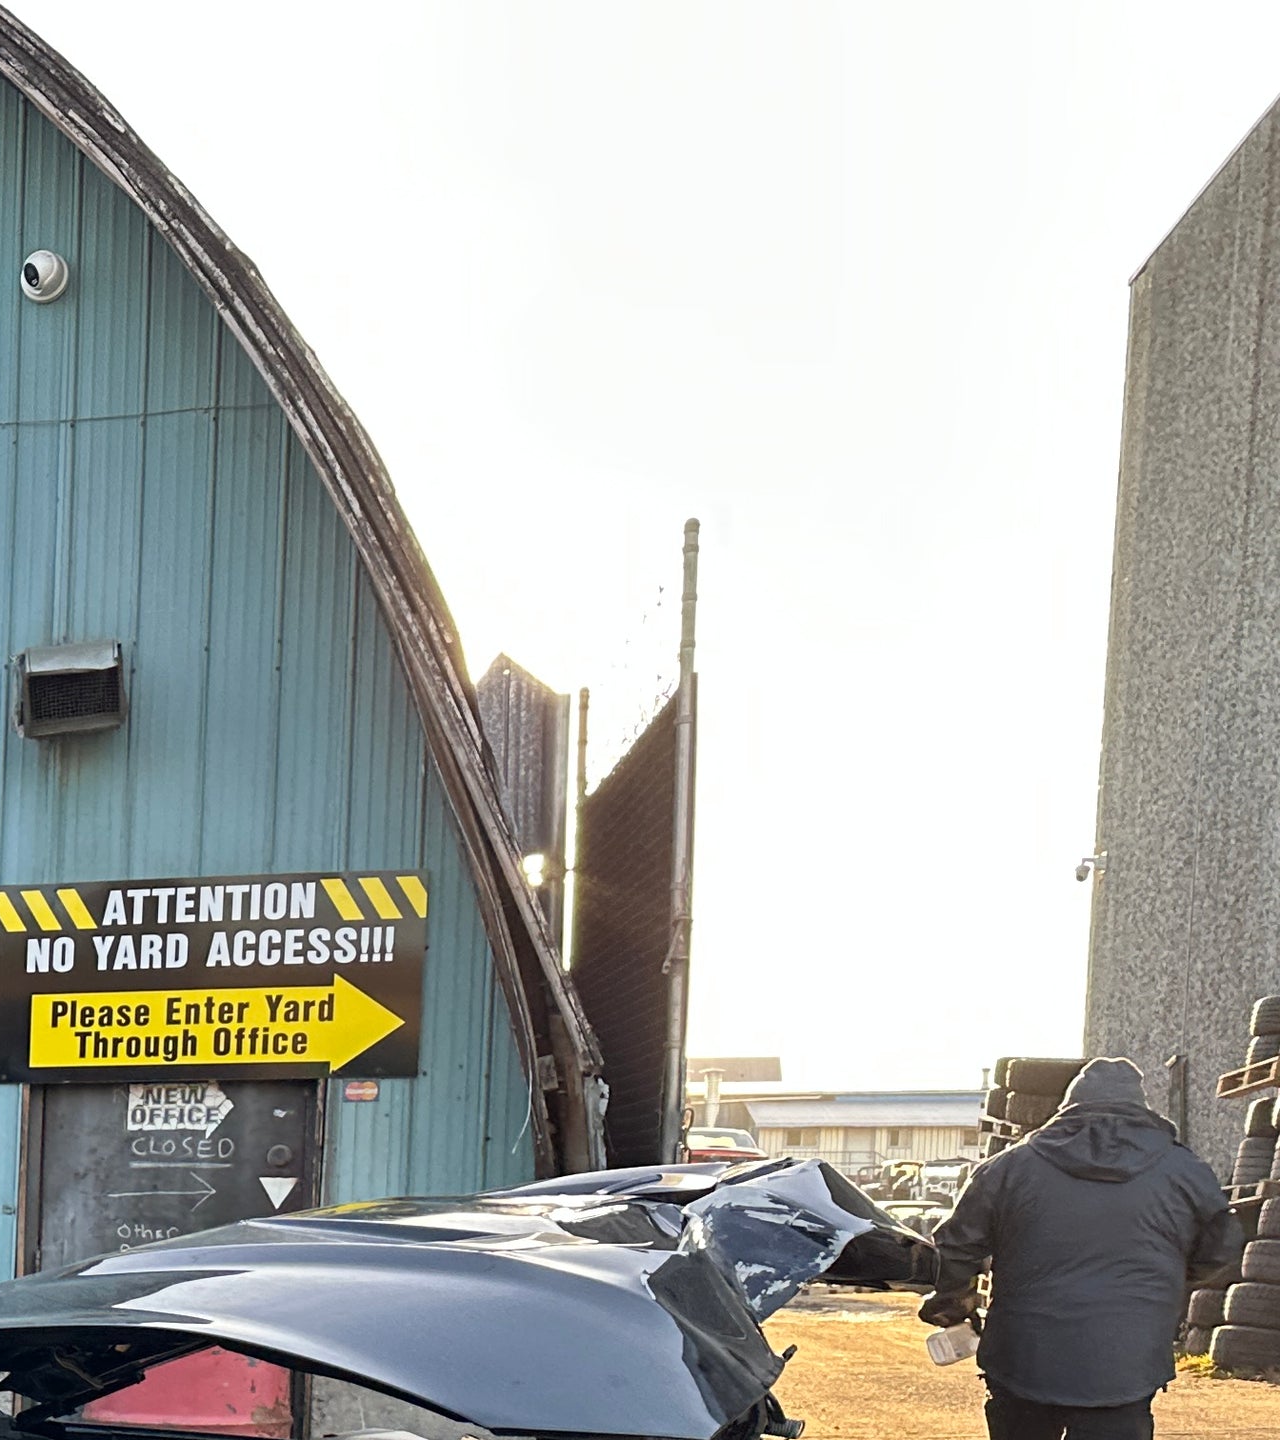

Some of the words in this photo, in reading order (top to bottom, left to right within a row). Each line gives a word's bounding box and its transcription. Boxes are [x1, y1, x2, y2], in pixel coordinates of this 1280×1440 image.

[101, 882, 316, 926] ATTENTION
[26, 936, 75, 973] NO
[93, 933, 189, 970] YARD
[206, 926, 395, 968] ACCESS!!!
[50, 999, 150, 1029] Please
[165, 997, 250, 1026] Enter
[265, 993, 335, 1023] Yard
[74, 1029, 198, 1062] Through
[213, 1027, 308, 1056] Office
[143, 1086, 204, 1105] NEW
[130, 1105, 220, 1126] OFFICE
[131, 1137, 235, 1159] CLOSED
[117, 1224, 179, 1240] Other
